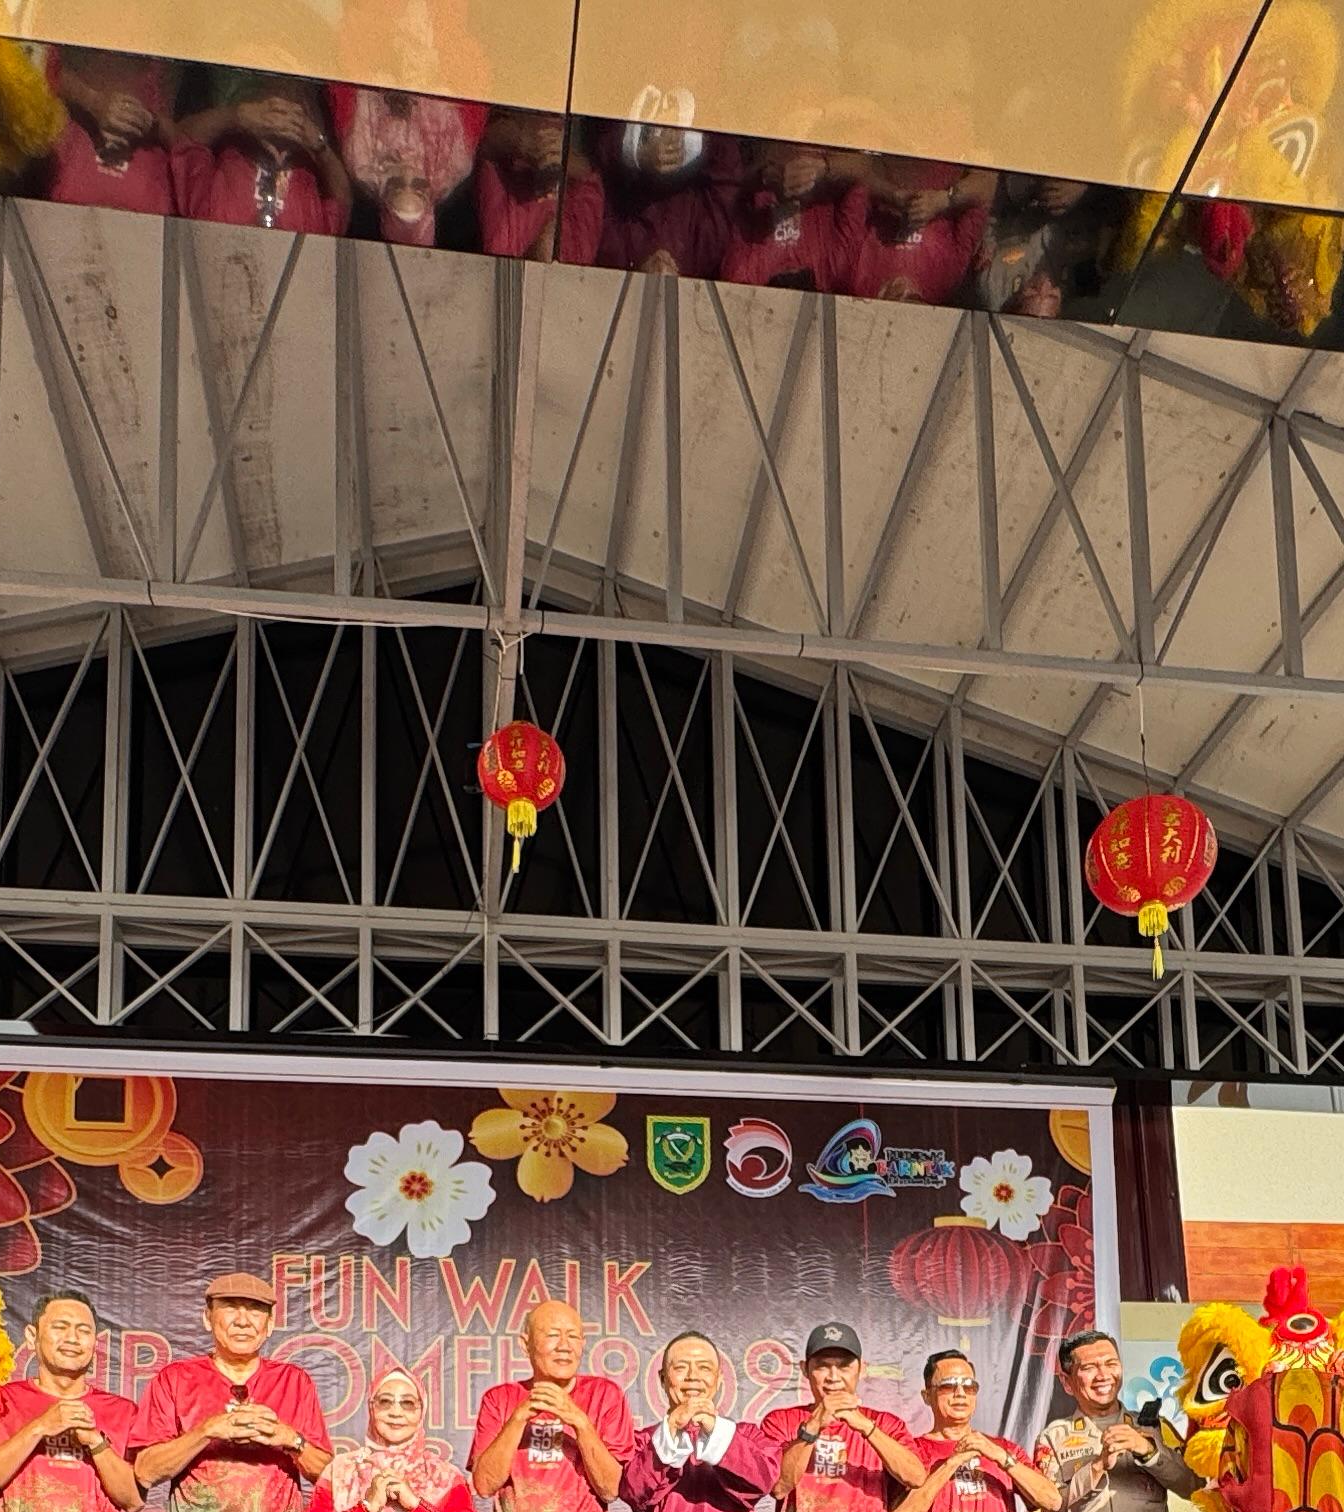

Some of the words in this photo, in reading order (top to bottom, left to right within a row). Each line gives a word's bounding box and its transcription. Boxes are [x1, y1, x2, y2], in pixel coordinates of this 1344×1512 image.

[273, 1255, 411, 1333] FUN
[438, 1257, 656, 1337] WALK
[531, 1424, 563, 1438] CAP
[531, 1438, 552, 1450] GO
[528, 1448, 564, 1463] MEH
[815, 1463, 847, 1477] MEH
[955, 1479, 987, 1495] MEH
